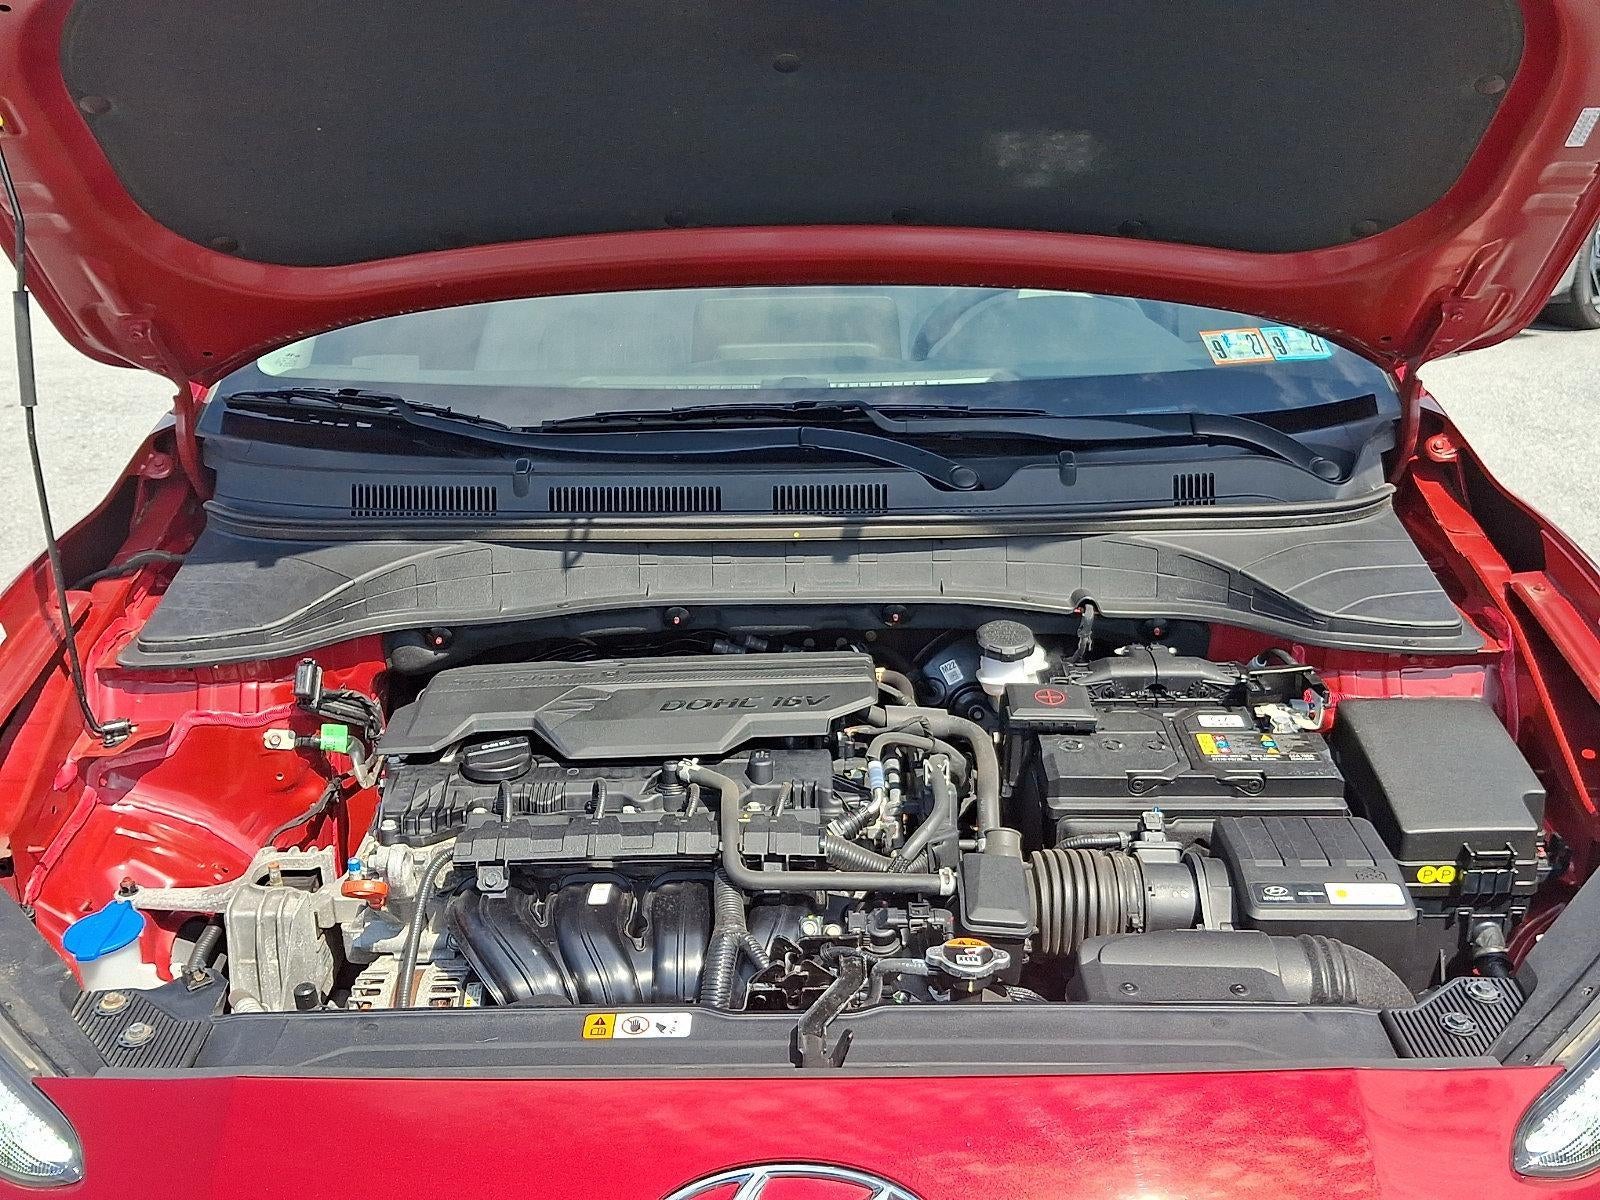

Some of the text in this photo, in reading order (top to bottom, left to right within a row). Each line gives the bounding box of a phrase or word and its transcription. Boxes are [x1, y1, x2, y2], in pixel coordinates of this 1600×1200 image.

[1212, 333, 1265, 359] 9 27
[1272, 336, 1287, 355] 9
[658, 694, 831, 713] DOHC 16V
[1423, 869, 1452, 879] P P
